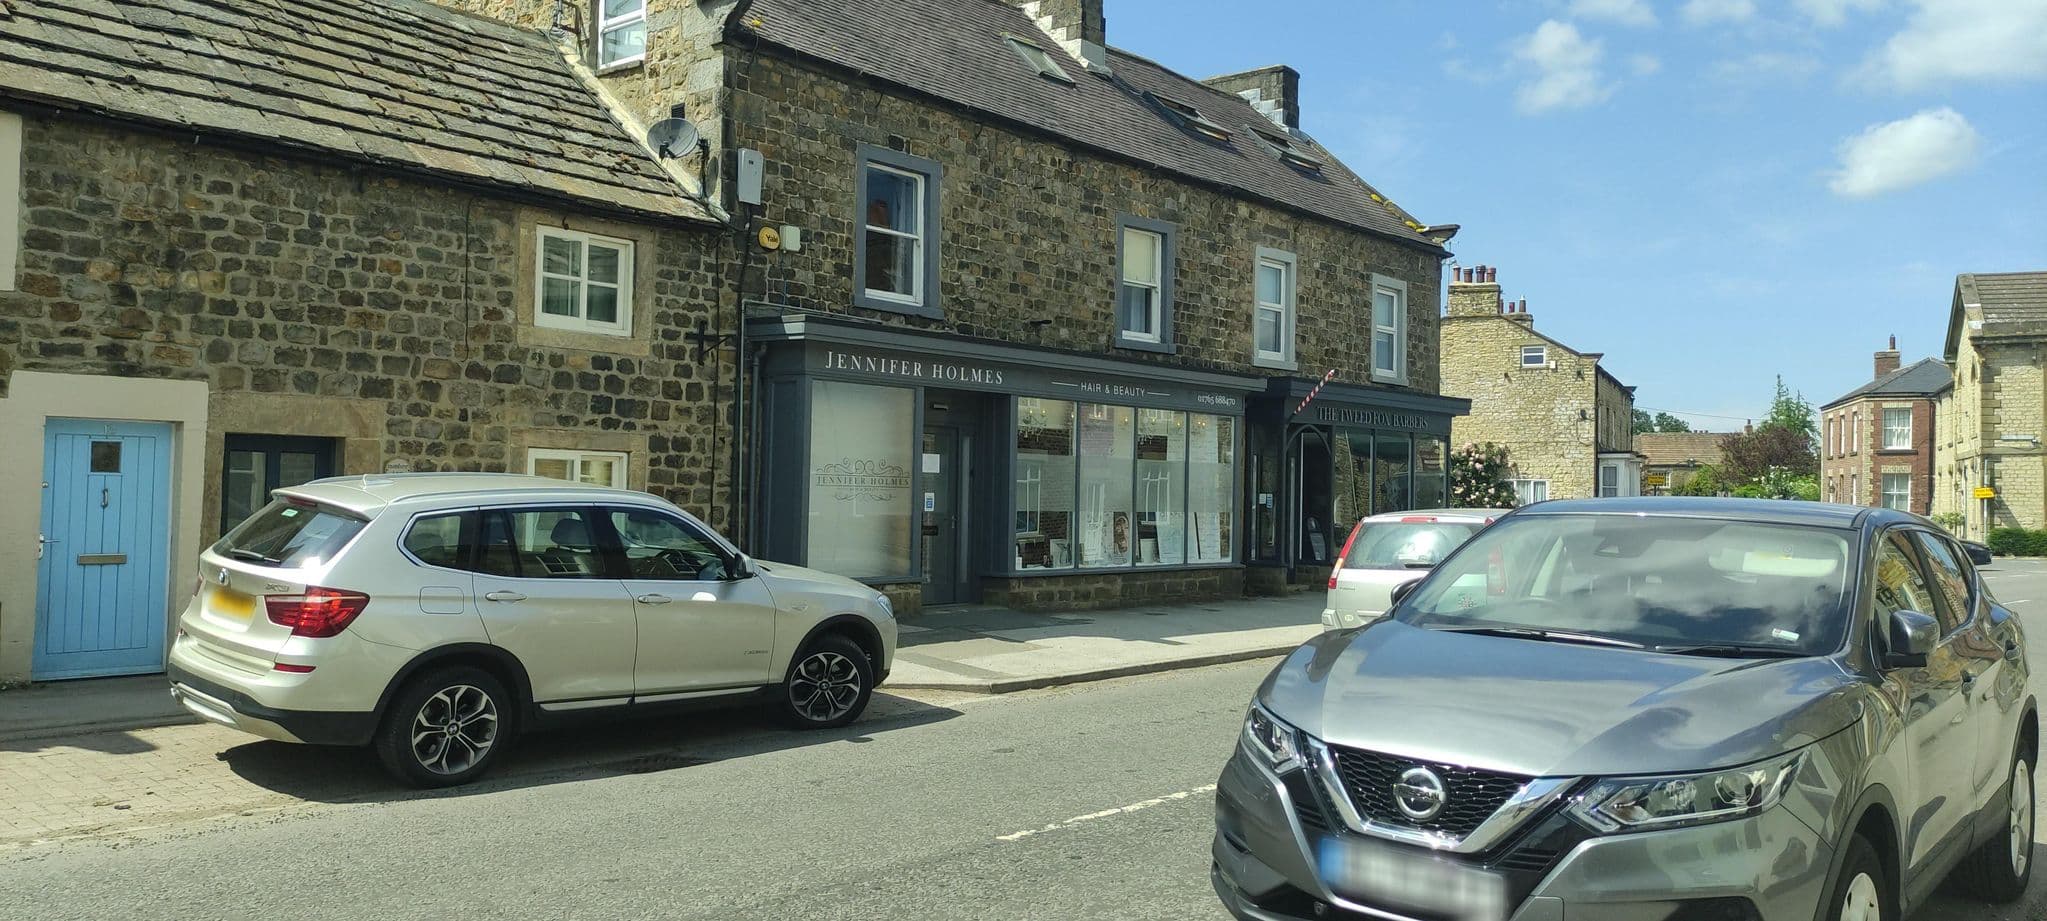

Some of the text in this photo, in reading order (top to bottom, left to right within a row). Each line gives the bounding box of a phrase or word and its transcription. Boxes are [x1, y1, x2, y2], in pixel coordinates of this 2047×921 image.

[825, 351, 1003, 385] JENNIFER HOLMES
[1080, 382, 1145, 397] HAIR & BEAUTY
[1317, 406, 1429, 429] THE TWEED FOX BARBERS
[817, 475, 909, 486] JENNIFER HOLMES
